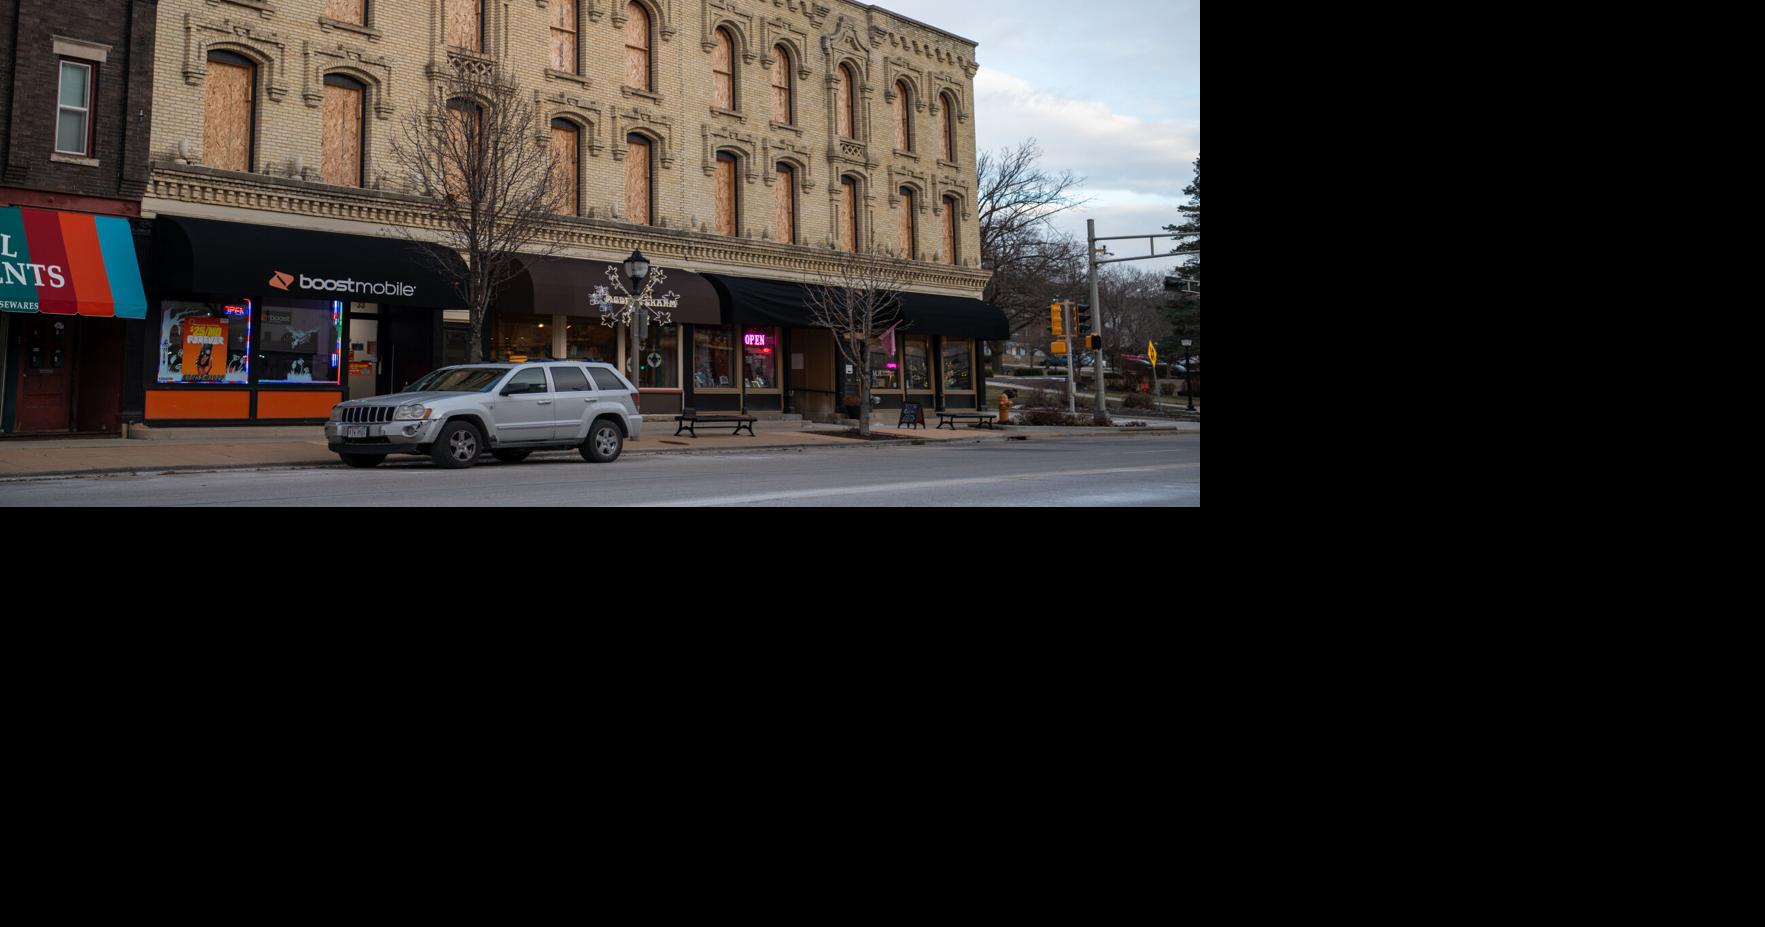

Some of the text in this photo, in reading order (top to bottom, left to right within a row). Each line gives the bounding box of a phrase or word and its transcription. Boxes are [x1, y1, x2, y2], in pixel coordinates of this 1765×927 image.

[0, 261, 65, 288] NTS
[299, 273, 416, 297] boostmobile
[744, 334, 766, 346] OPEN
